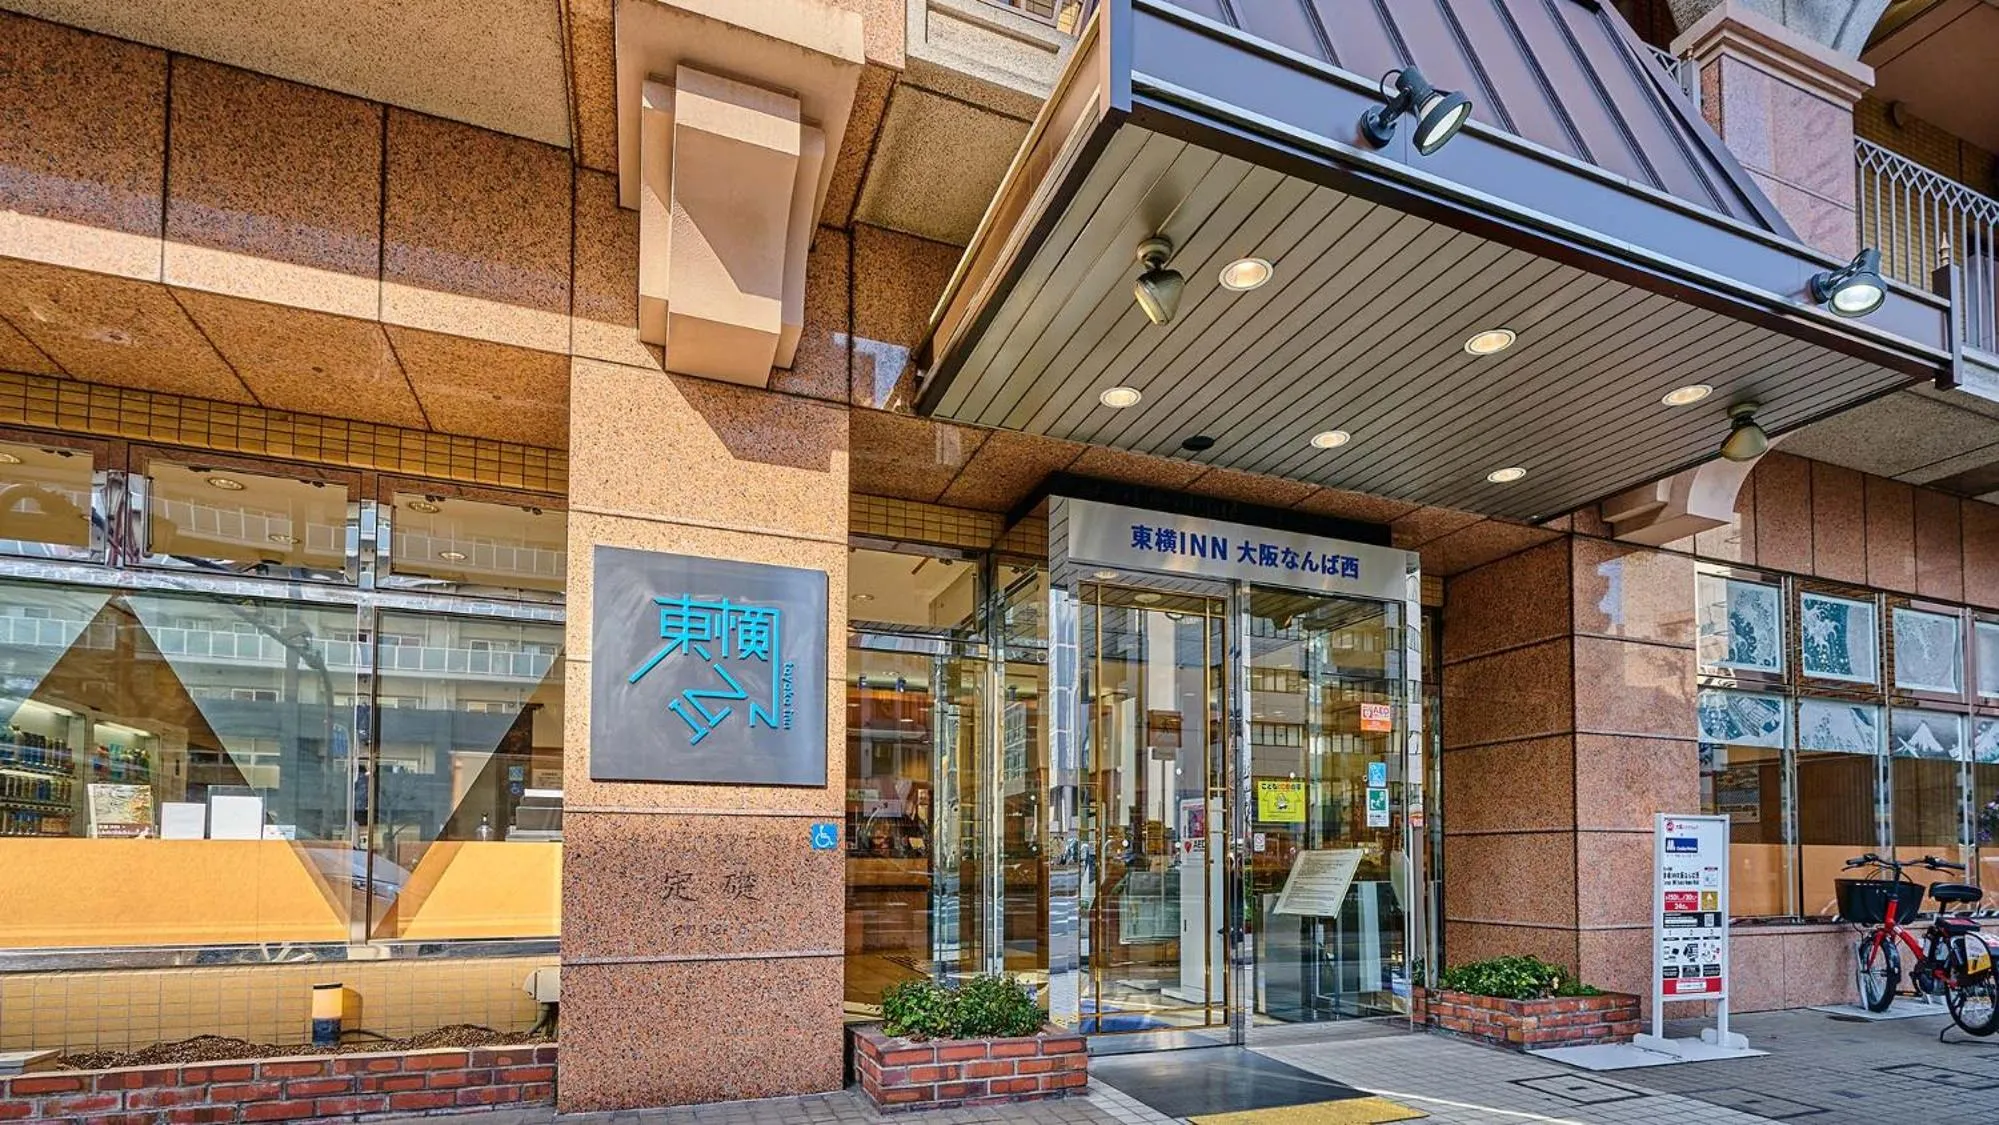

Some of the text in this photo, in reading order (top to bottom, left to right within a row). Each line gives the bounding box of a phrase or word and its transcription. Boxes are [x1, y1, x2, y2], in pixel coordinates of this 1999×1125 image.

[1130, 524, 1360, 579] 東横INN 大阪なんば西
